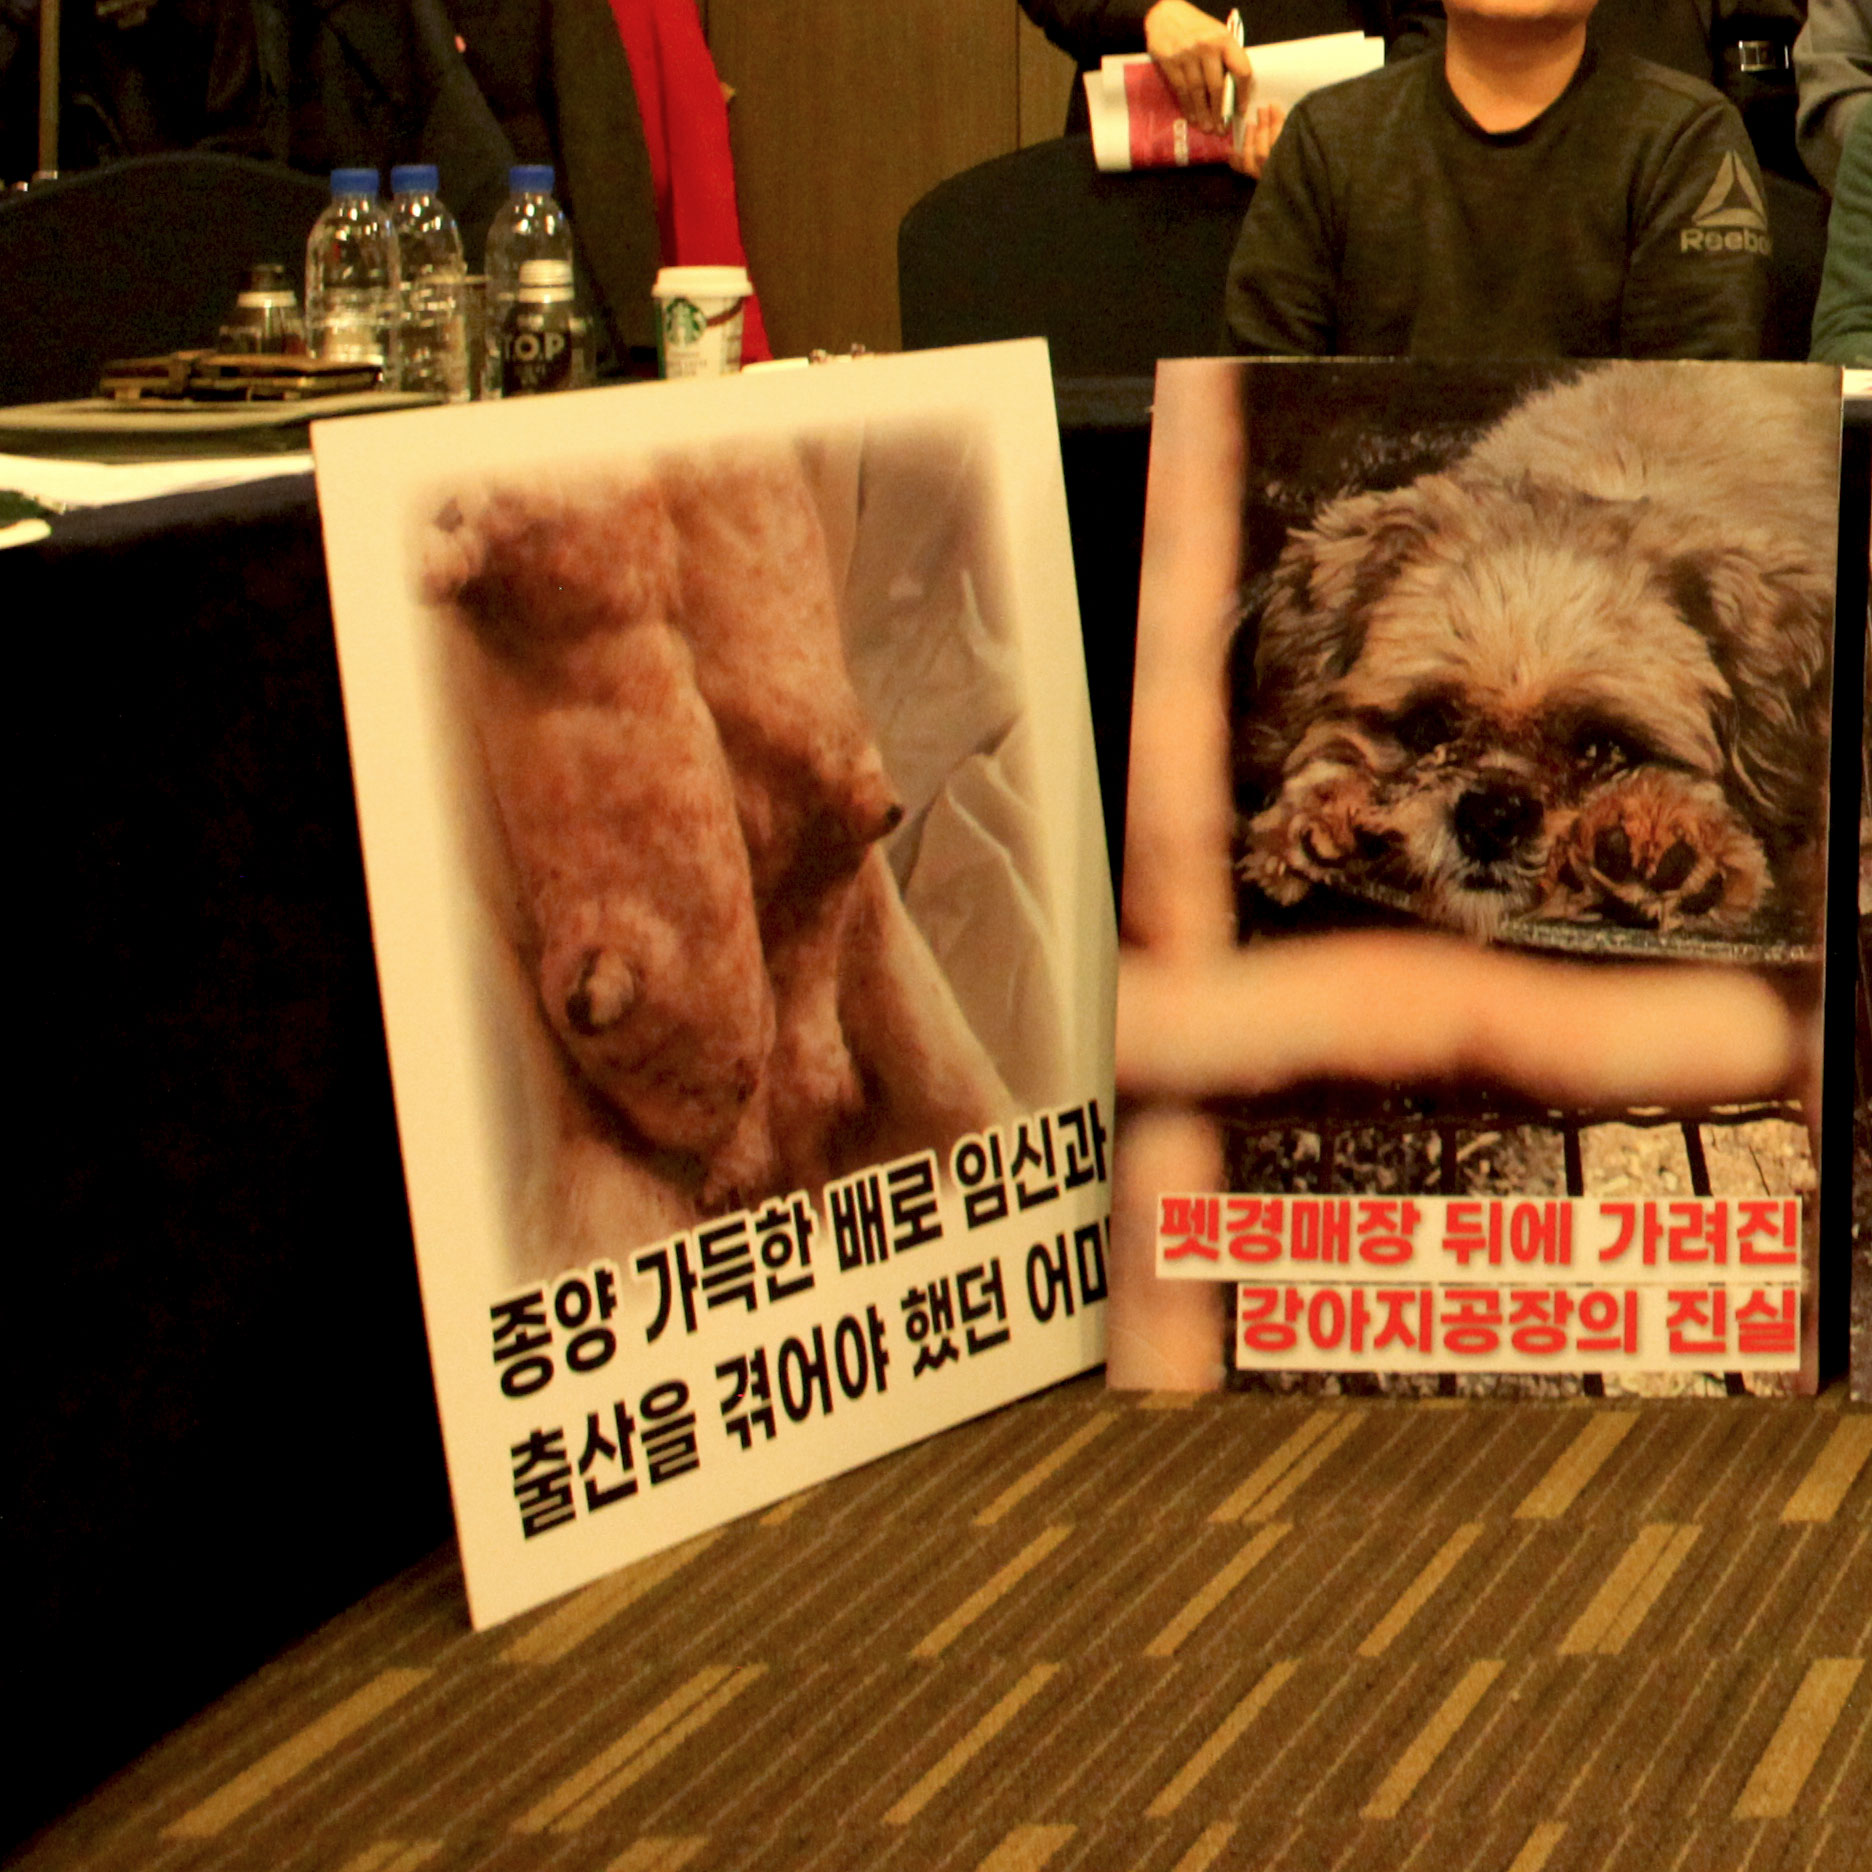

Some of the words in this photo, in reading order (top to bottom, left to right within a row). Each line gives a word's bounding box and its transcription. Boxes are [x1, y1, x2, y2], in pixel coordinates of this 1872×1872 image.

[1681, 228, 1771, 255] Reebo
[490, 1266, 619, 1399] 종양
[636, 1200, 815, 1345] 가득한
[829, 1155, 943, 1273] 배로
[955, 1099, 1107, 1229] 임신과
[1161, 1198, 1420, 1265] 펫경매장
[1442, 1201, 1573, 1265] 뒤에
[1598, 1200, 1798, 1265] 가려진
[1241, 1287, 1638, 1354] 강아지공장의
[1666, 1288, 1797, 1354] 진실
[511, 1380, 701, 1540] 출산을
[715, 1304, 890, 1451] 겪어야
[901, 1257, 1011, 1377] 했던
